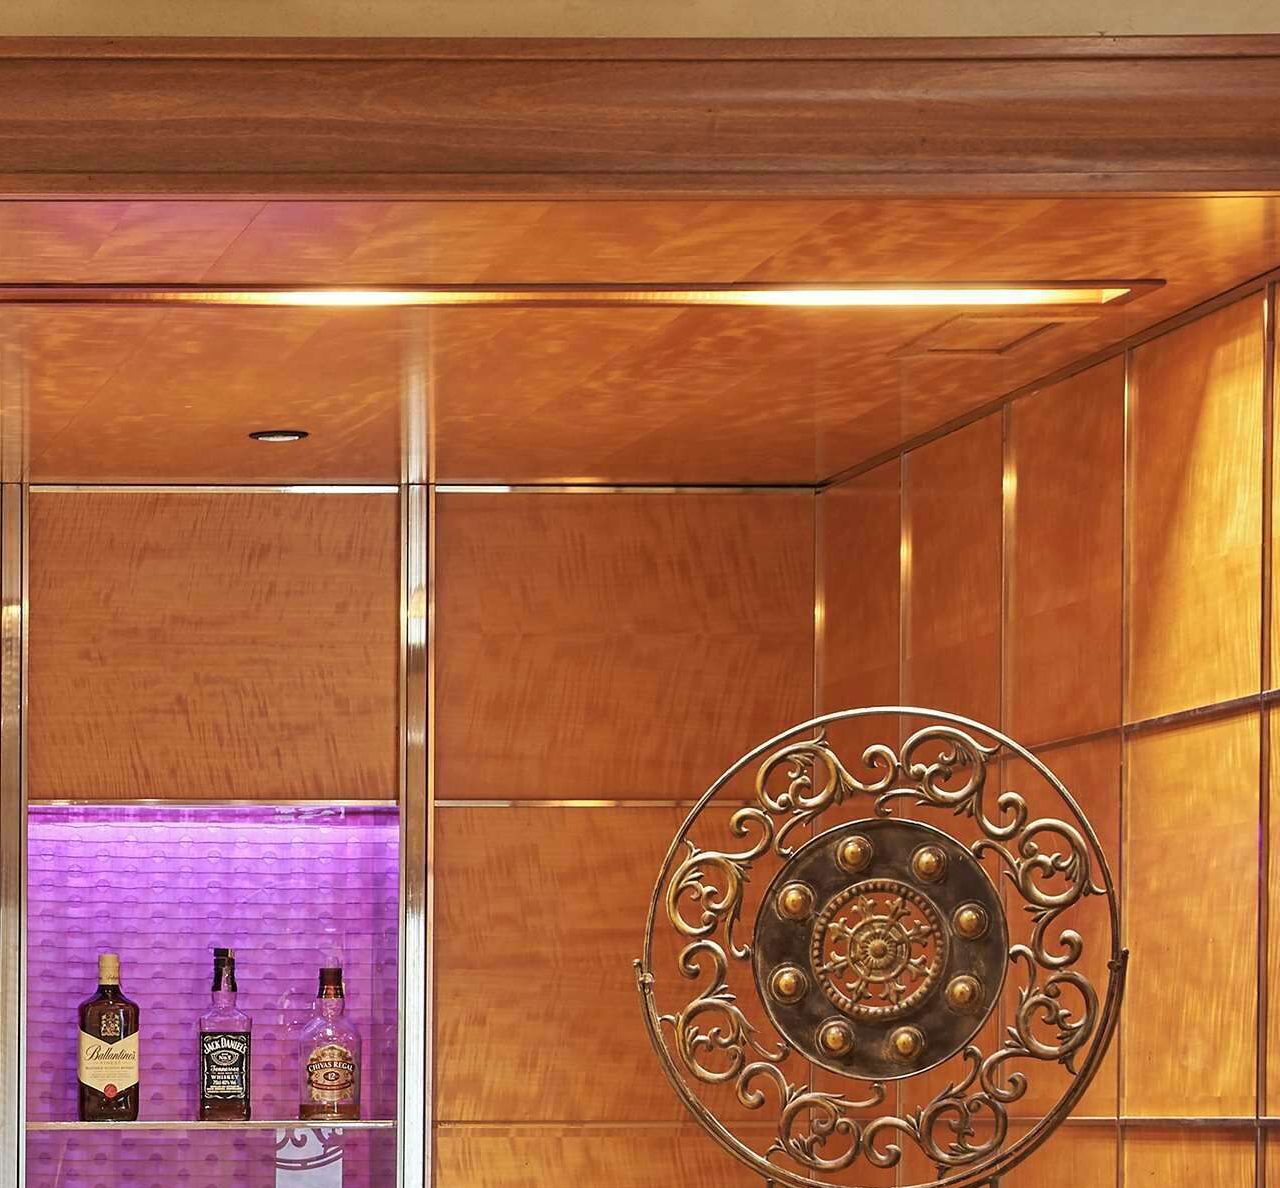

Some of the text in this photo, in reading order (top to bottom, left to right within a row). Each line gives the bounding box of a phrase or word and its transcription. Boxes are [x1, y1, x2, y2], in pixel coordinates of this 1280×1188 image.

[85, 1045, 136, 1061] Ballantine's
[203, 1040, 221, 1055] JACK
[308, 1061, 353, 1072] CHIVAS REGAL
[328, 1072, 336, 1080] 12
